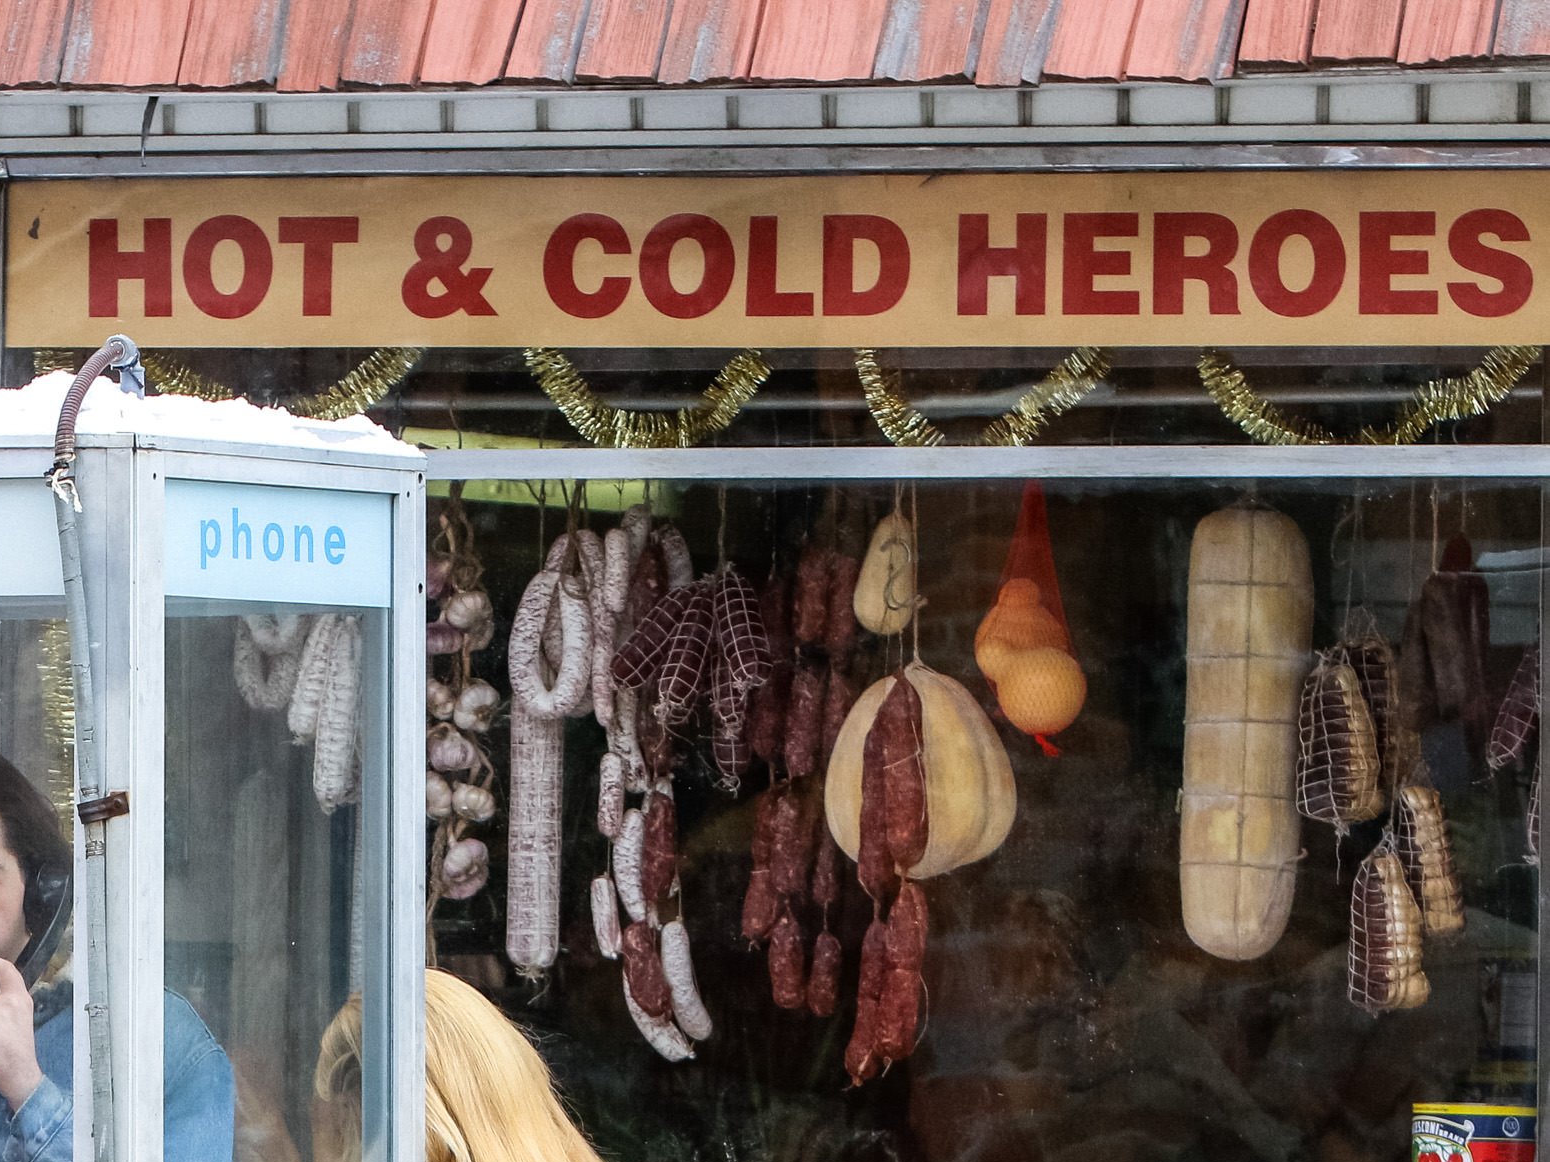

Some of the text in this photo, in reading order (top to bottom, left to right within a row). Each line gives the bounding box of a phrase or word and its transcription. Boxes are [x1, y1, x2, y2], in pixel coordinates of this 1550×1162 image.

[89, 209, 1534, 318] HOT & COLD HEROES
[200, 507, 347, 570] phone
[1439, 1128, 1465, 1145] BRAND
